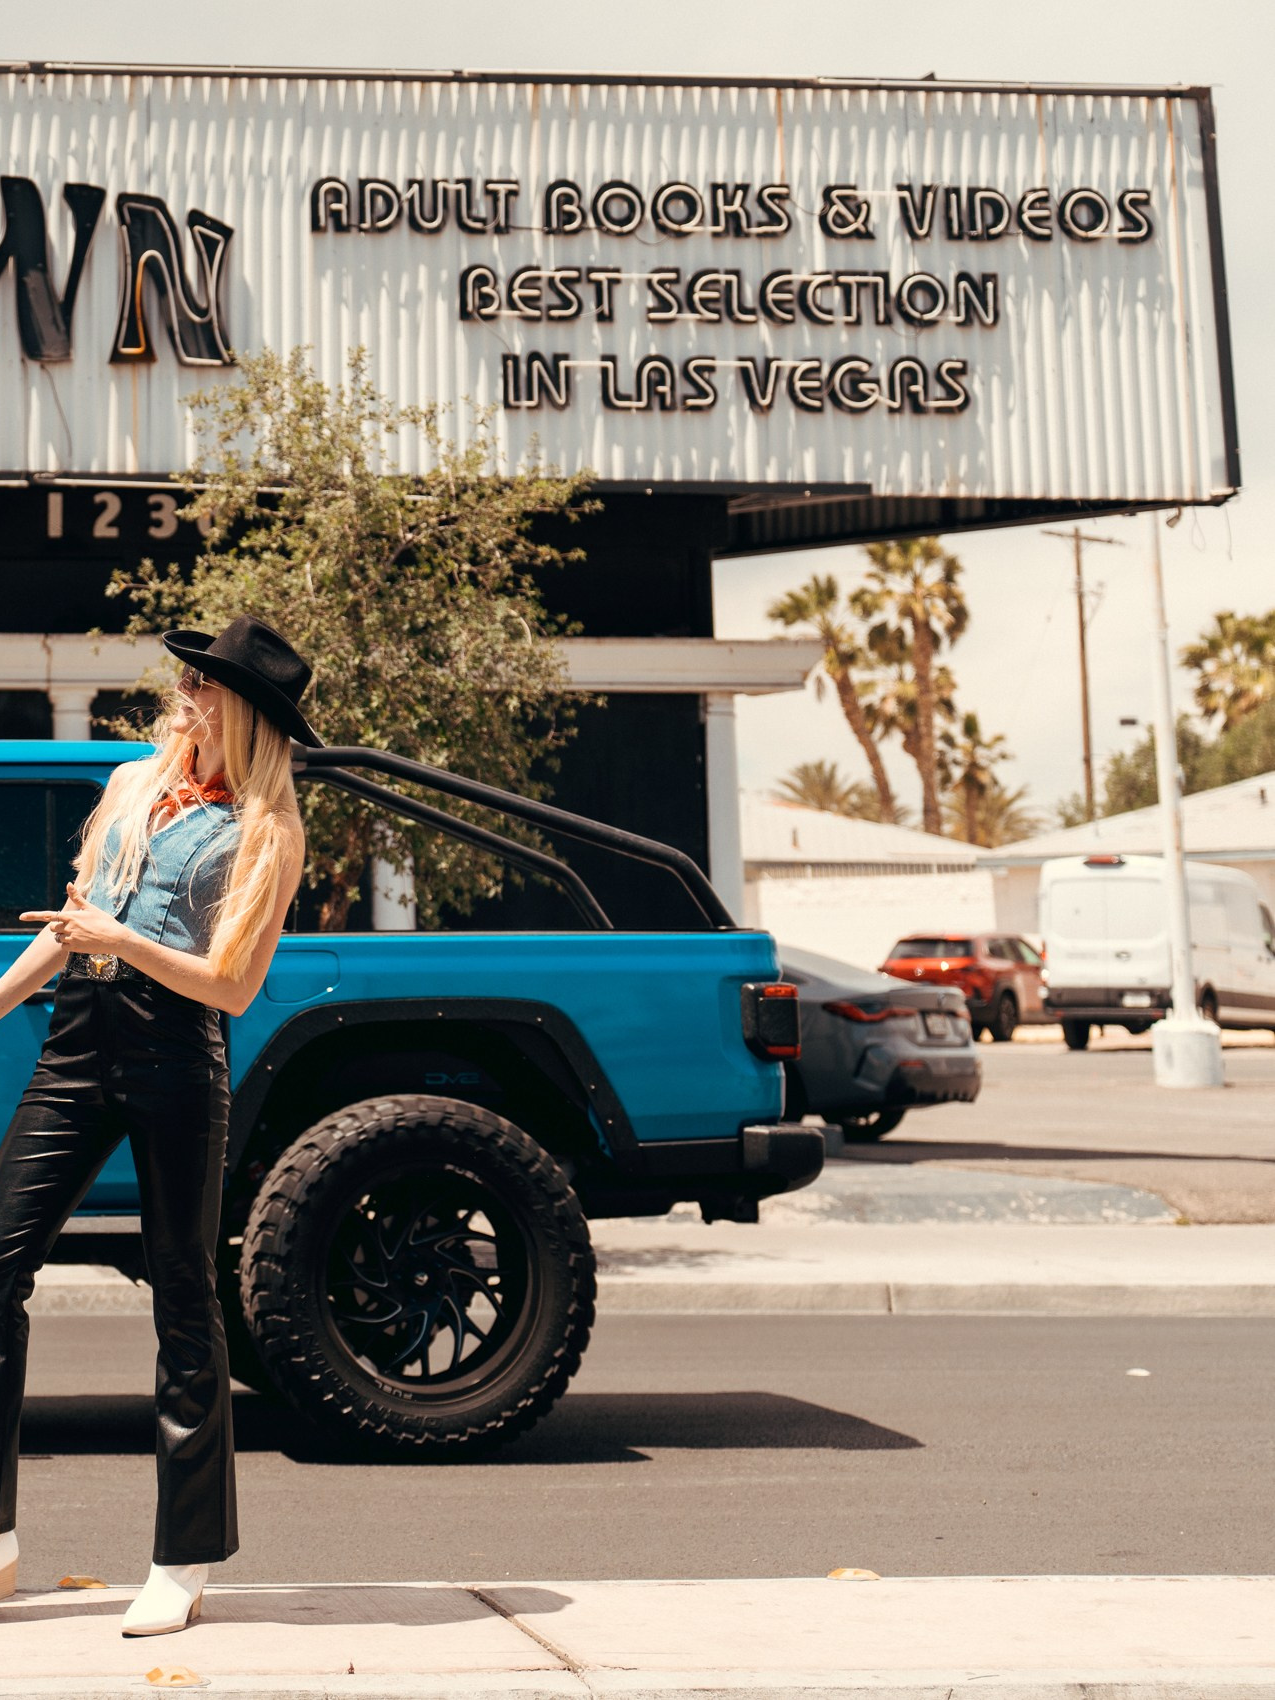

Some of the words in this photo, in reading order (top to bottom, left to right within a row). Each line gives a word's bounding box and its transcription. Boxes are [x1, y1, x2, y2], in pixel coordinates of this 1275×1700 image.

[311, 176, 519, 233] ADULT
[544, 179, 792, 239] BOOKS
[819, 184, 875, 240] &
[896, 183, 1154, 244] VIDEOS
[459, 264, 621, 322] BEST
[647, 267, 998, 328] SELECTION
[501, 351, 570, 410] IN
[600, 353, 717, 412] LAS
[737, 355, 971, 414] VEGAS
[375, 1379, 413, 1400] FUEL
